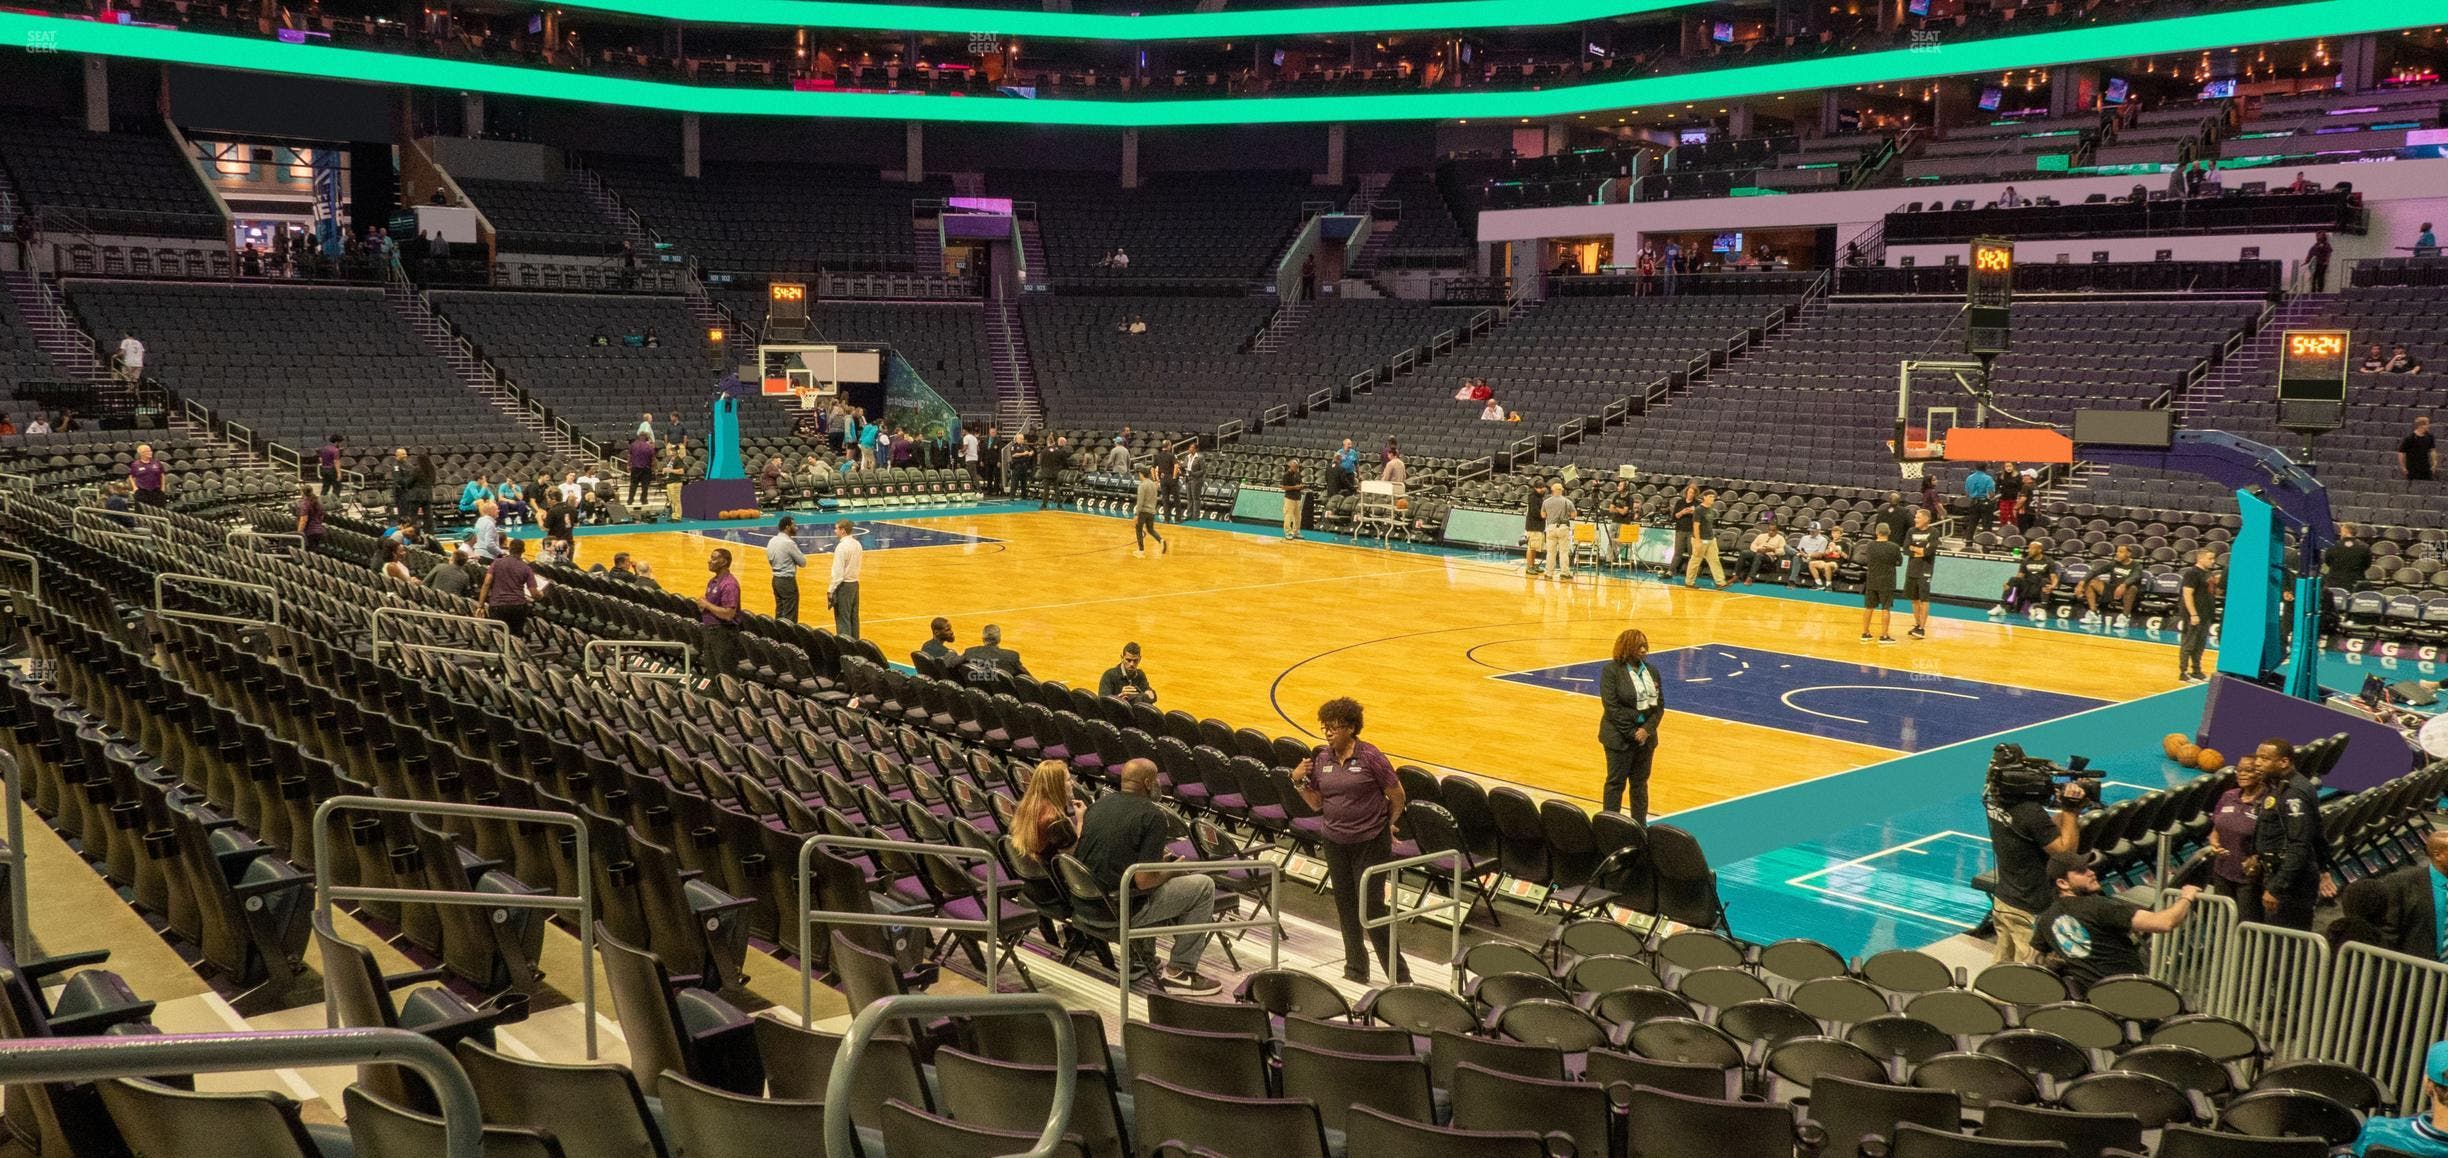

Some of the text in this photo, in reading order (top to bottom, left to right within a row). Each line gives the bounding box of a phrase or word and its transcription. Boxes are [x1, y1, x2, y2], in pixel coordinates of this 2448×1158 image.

[1977, 248, 2010, 270] 54:24
[773, 286, 802, 299] 54:24
[2292, 336, 2341, 355] 54:24
[2056, 605, 2072, 618] G
[2146, 616, 2163, 630] G
[2346, 638, 2364, 652] G
[2381, 642, 2400, 656] G
[2419, 646, 2437, 660] G
[1402, 893, 1410, 903] 2
